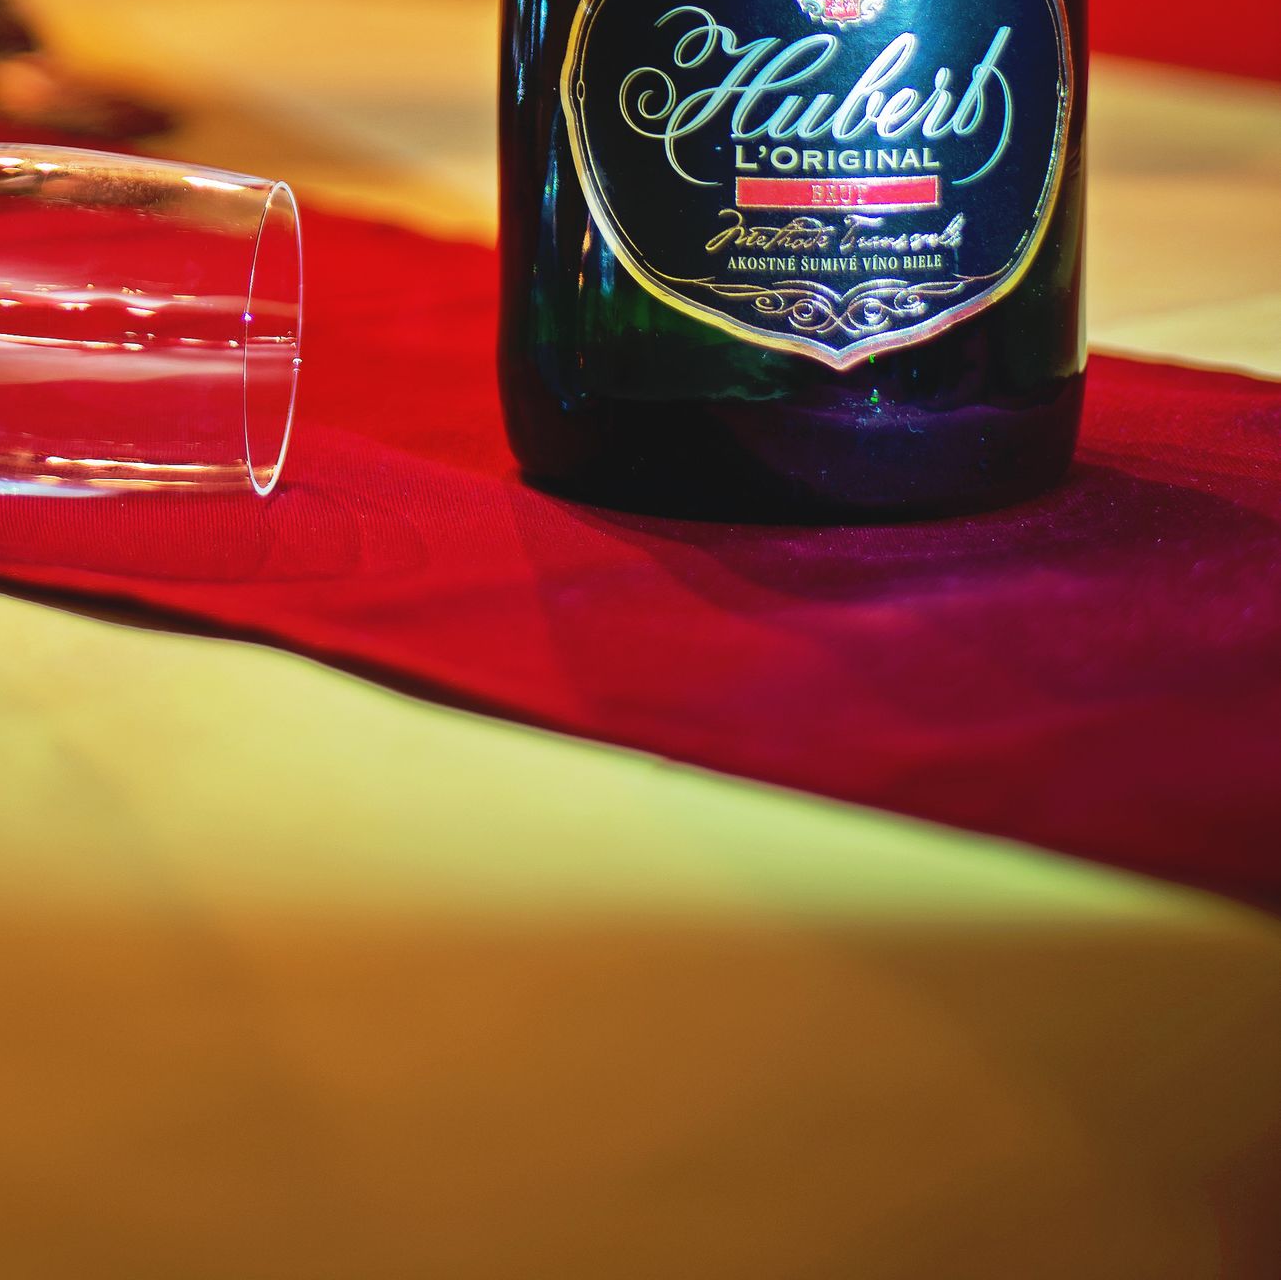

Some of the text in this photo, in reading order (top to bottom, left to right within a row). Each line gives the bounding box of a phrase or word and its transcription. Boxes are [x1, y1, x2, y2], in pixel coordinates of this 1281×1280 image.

[619, 5, 1012, 185] Hubert
[735, 144, 940, 170] L'ORIGINAL
[811, 184, 868, 205] BRUT
[727, 253, 942, 272] AKOSTNÉ ŠUMIVÉ VÍNO BIELE
